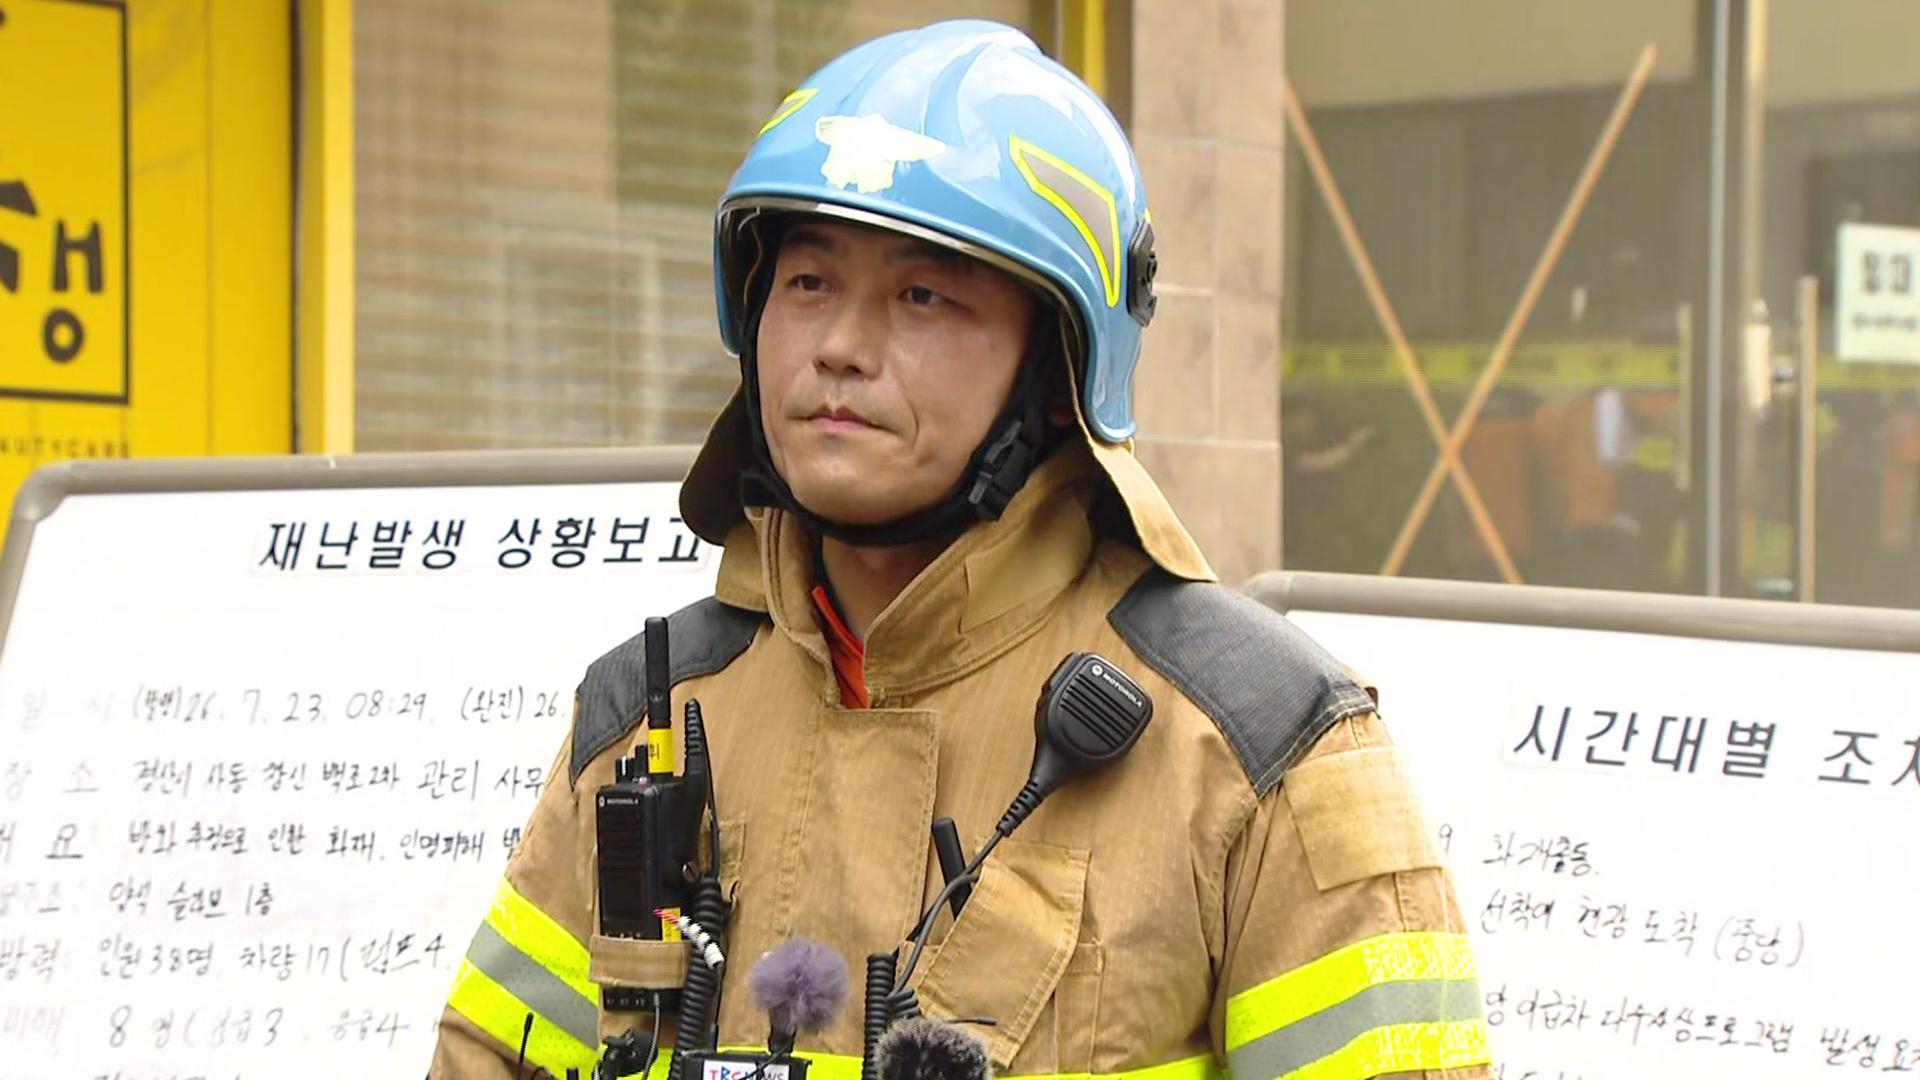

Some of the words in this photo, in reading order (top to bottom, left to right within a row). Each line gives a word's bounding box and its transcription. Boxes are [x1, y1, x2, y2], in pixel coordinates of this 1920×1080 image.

[259, 519, 466, 572] 재난발생
[497, 516, 701, 570] 상황보고
[1513, 704, 1776, 778] 시간대별
